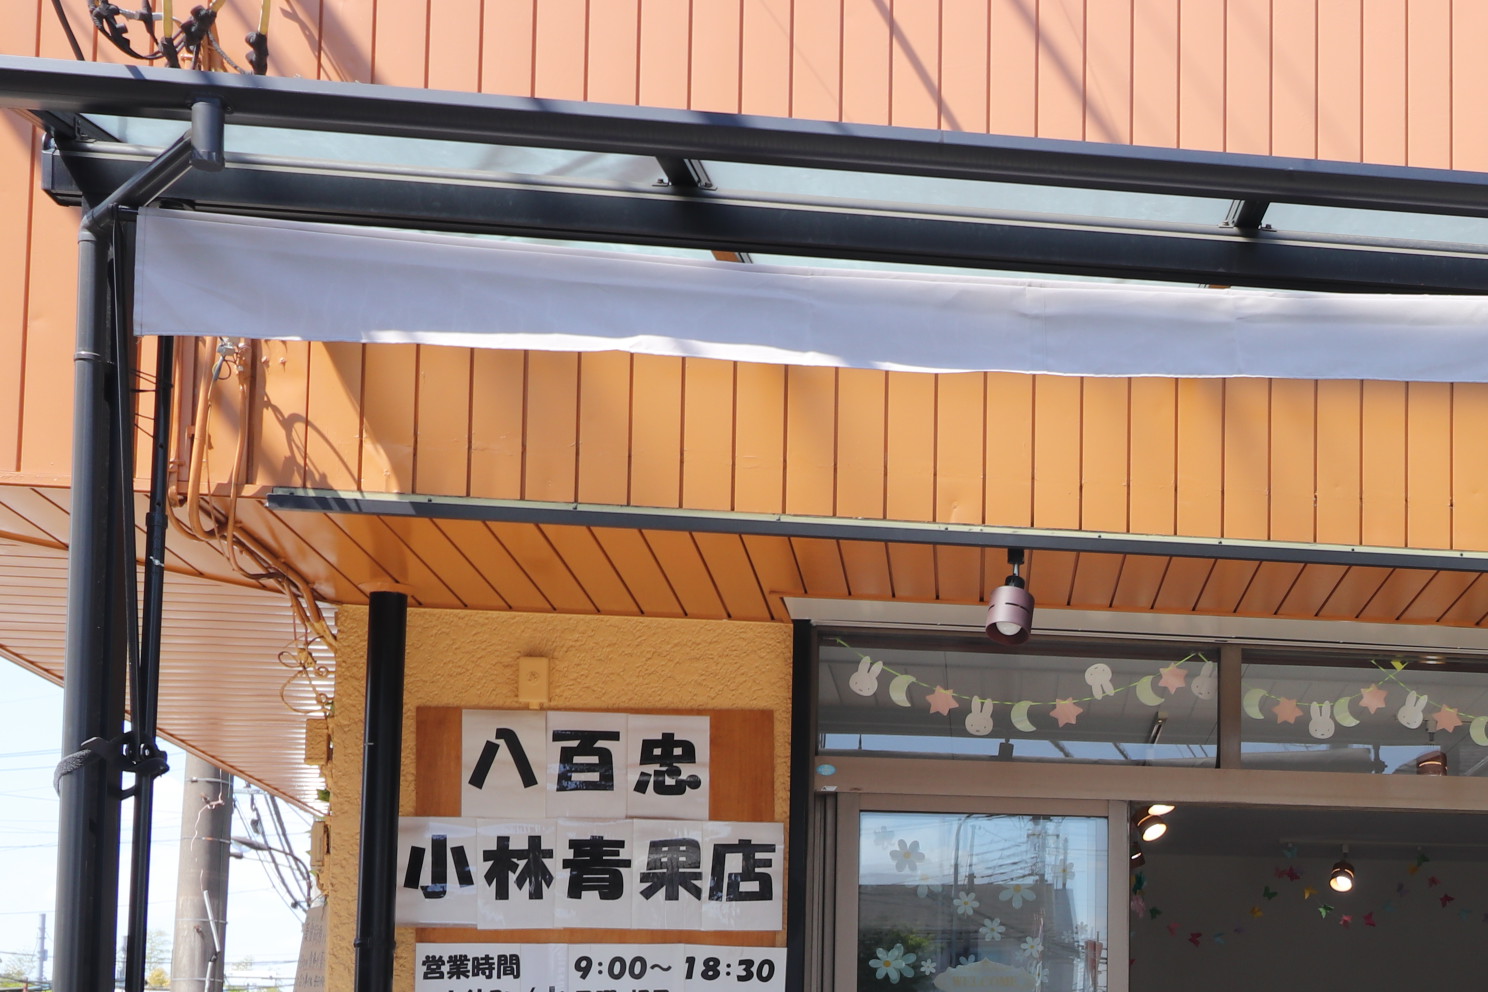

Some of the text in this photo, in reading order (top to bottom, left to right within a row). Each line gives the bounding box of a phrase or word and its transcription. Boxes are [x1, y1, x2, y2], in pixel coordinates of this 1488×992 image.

[467, 727, 702, 797] 八百忠
[402, 833, 777, 902] 小林青果店
[421, 954, 521, 980] 営業時間
